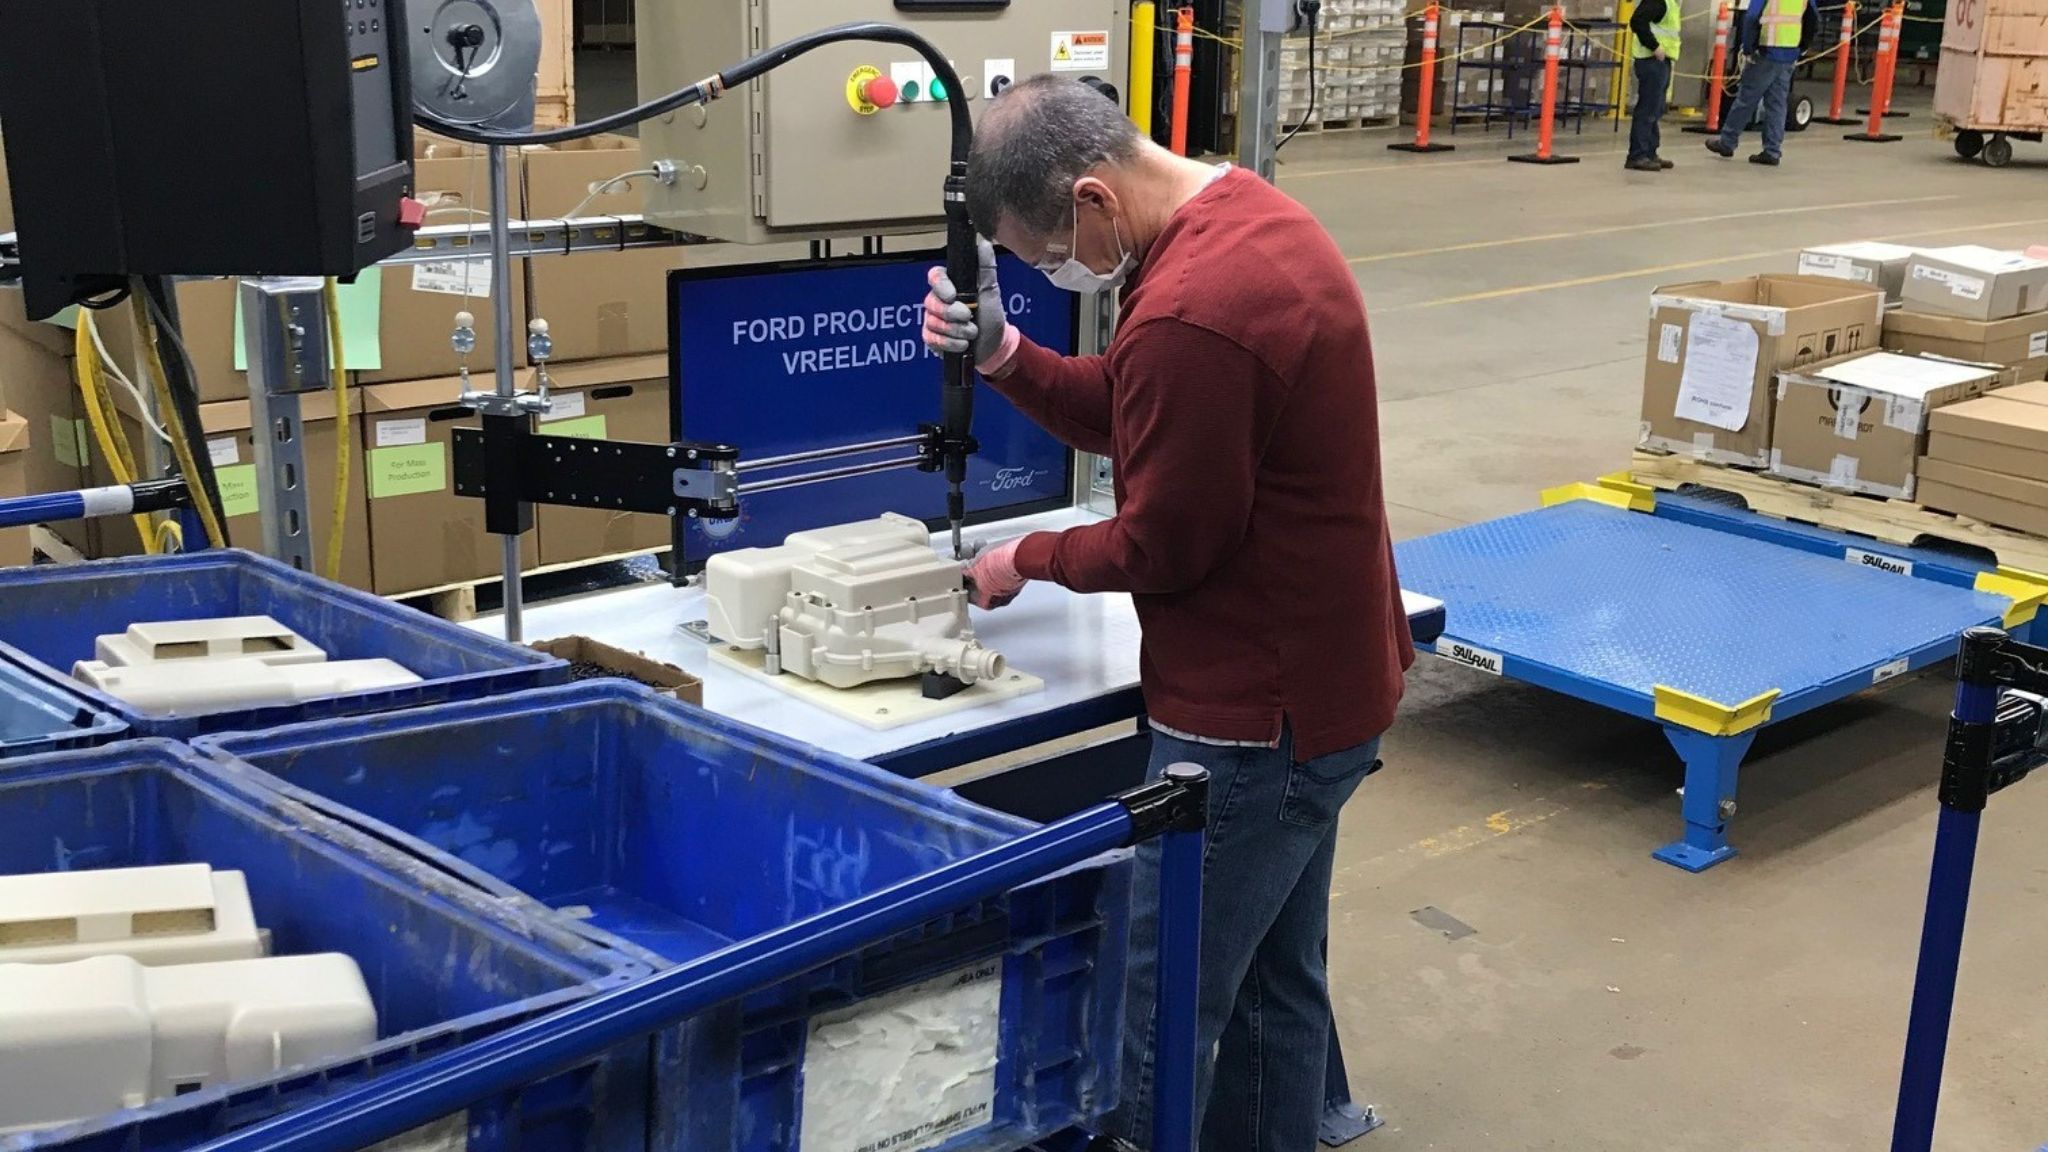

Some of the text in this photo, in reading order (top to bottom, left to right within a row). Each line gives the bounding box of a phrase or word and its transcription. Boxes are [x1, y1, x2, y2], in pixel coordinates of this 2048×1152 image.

[733, 304, 925, 345] FORD PROJECT
[782, 339, 916, 375] VREELAND
[991, 466, 1034, 492] Ford
[1453, 645, 1497, 671] SAILRAIL
[975, 966, 996, 979] ONLY
